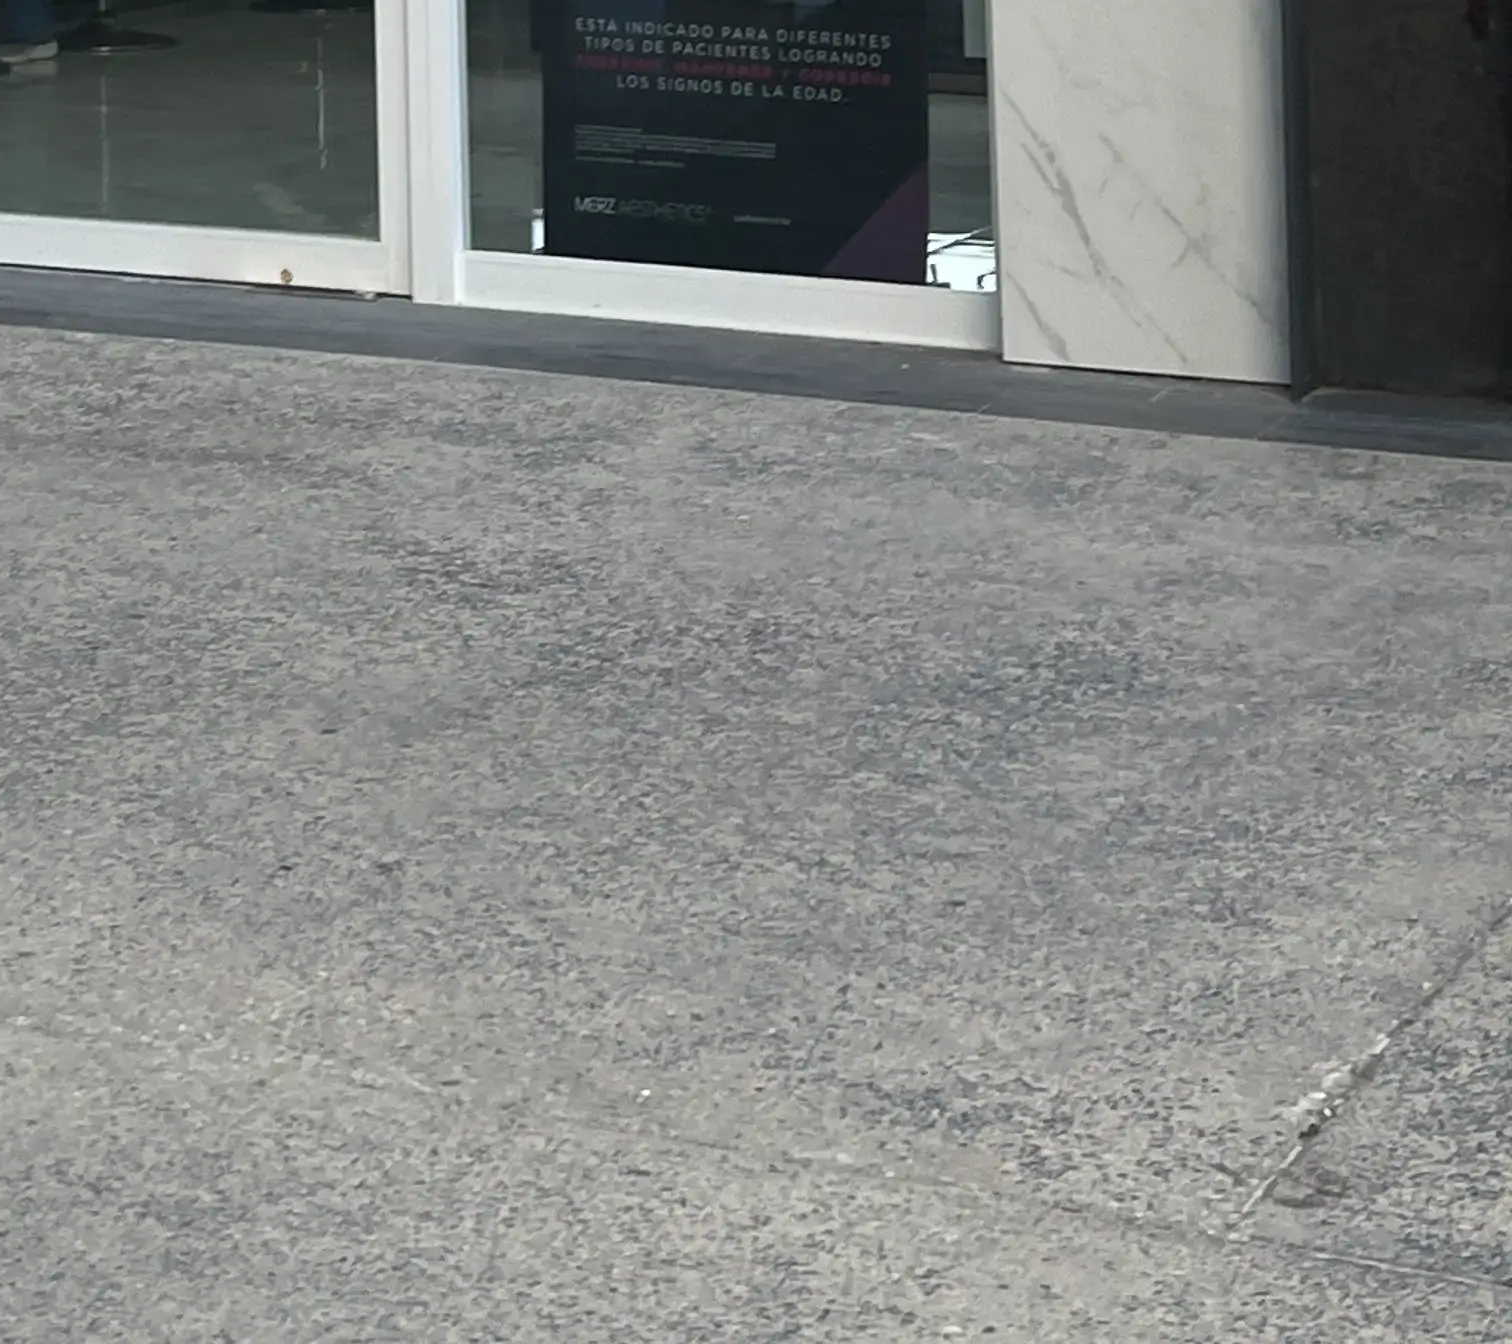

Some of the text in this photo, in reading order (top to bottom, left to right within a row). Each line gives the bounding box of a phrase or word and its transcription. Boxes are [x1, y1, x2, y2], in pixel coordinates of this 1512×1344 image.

[625, 20, 715, 39] INDICADO
[721, 25, 769, 42] PARA
[776, 29, 893, 50] DIFERENTES
[584, 35, 883, 68] TIPOS DE PACIENTES LOGRANDO
[616, 73, 650, 91] LOS
[656, 76, 725, 96] SIGNOS
[731, 80, 754, 98] DE
[762, 82, 785, 99] LA
